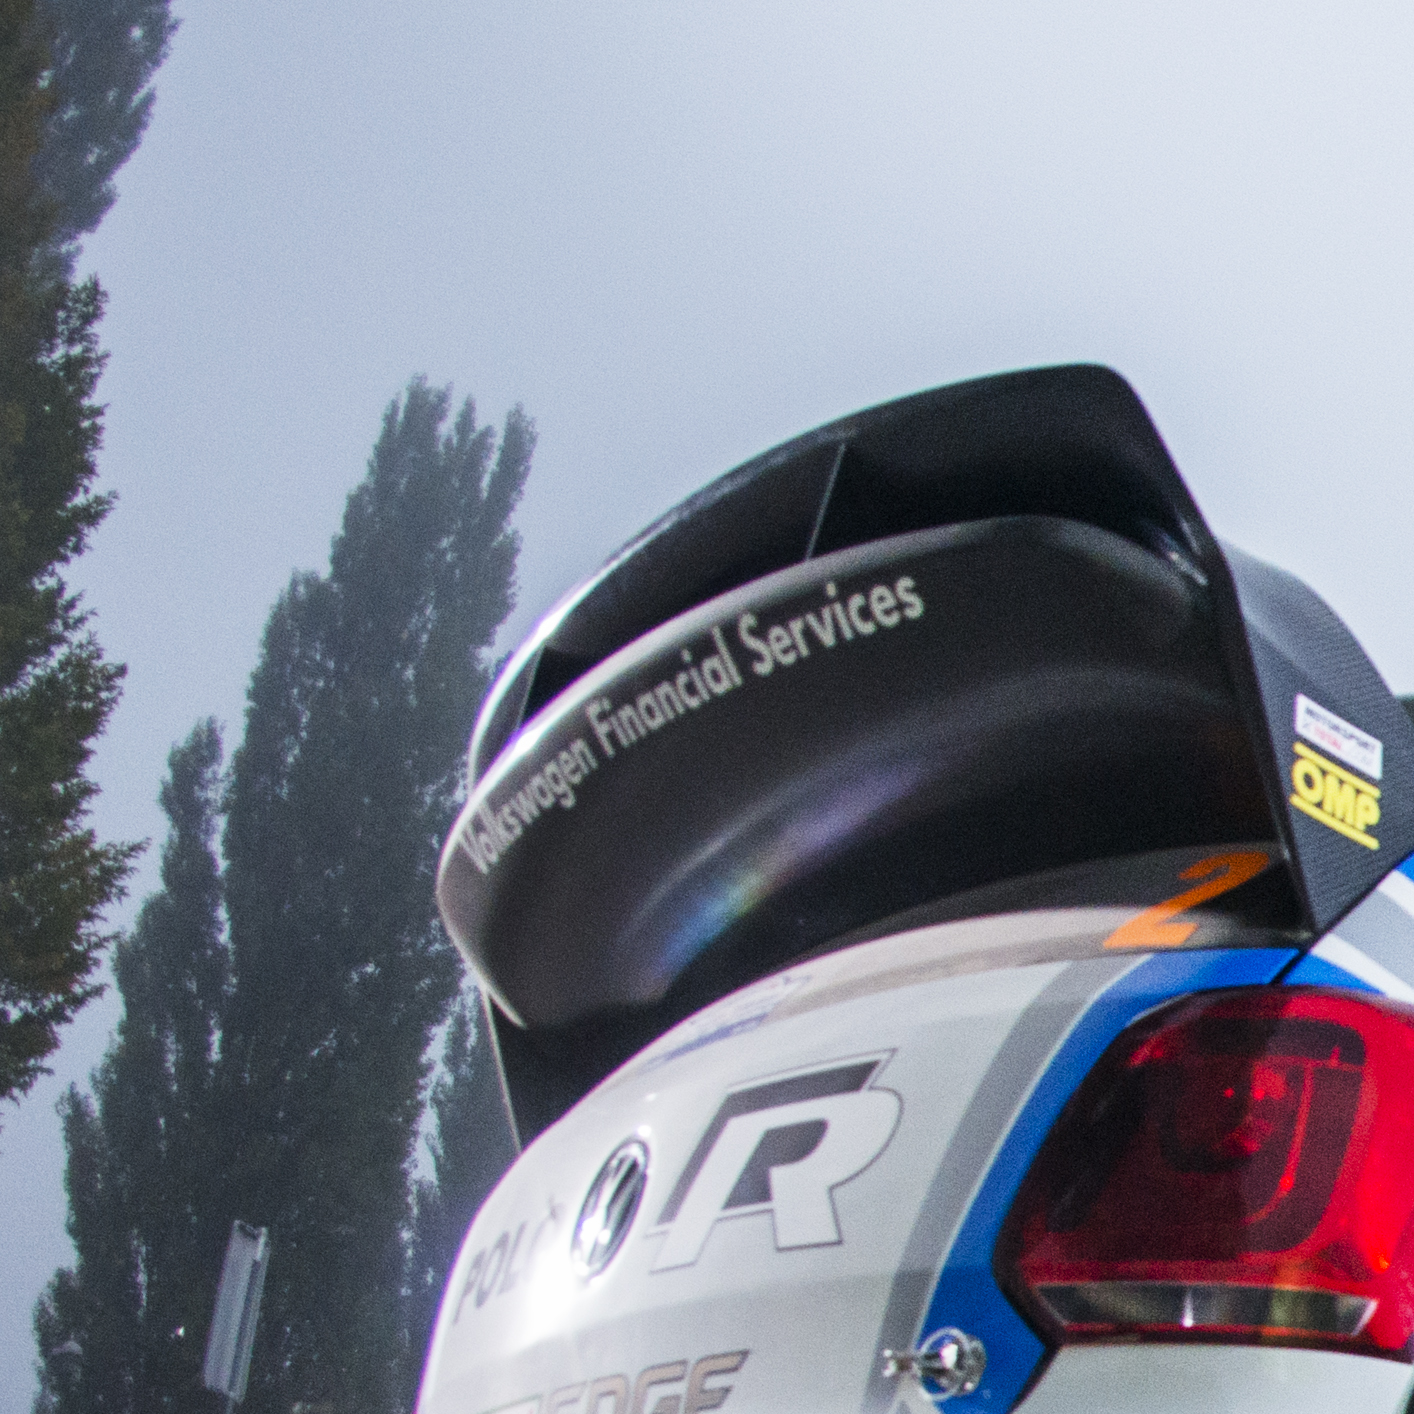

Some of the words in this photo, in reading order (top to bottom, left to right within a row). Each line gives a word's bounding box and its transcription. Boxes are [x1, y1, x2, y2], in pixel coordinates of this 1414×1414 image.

[455, 742, 596, 874] Volkswagen
[586, 626, 742, 757] Financial
[738, 575, 924, 676] Services
[1291, 758, 1381, 831] OMP
[1103, 851, 1269, 948] 2
[644, 1047, 904, 1276] R
